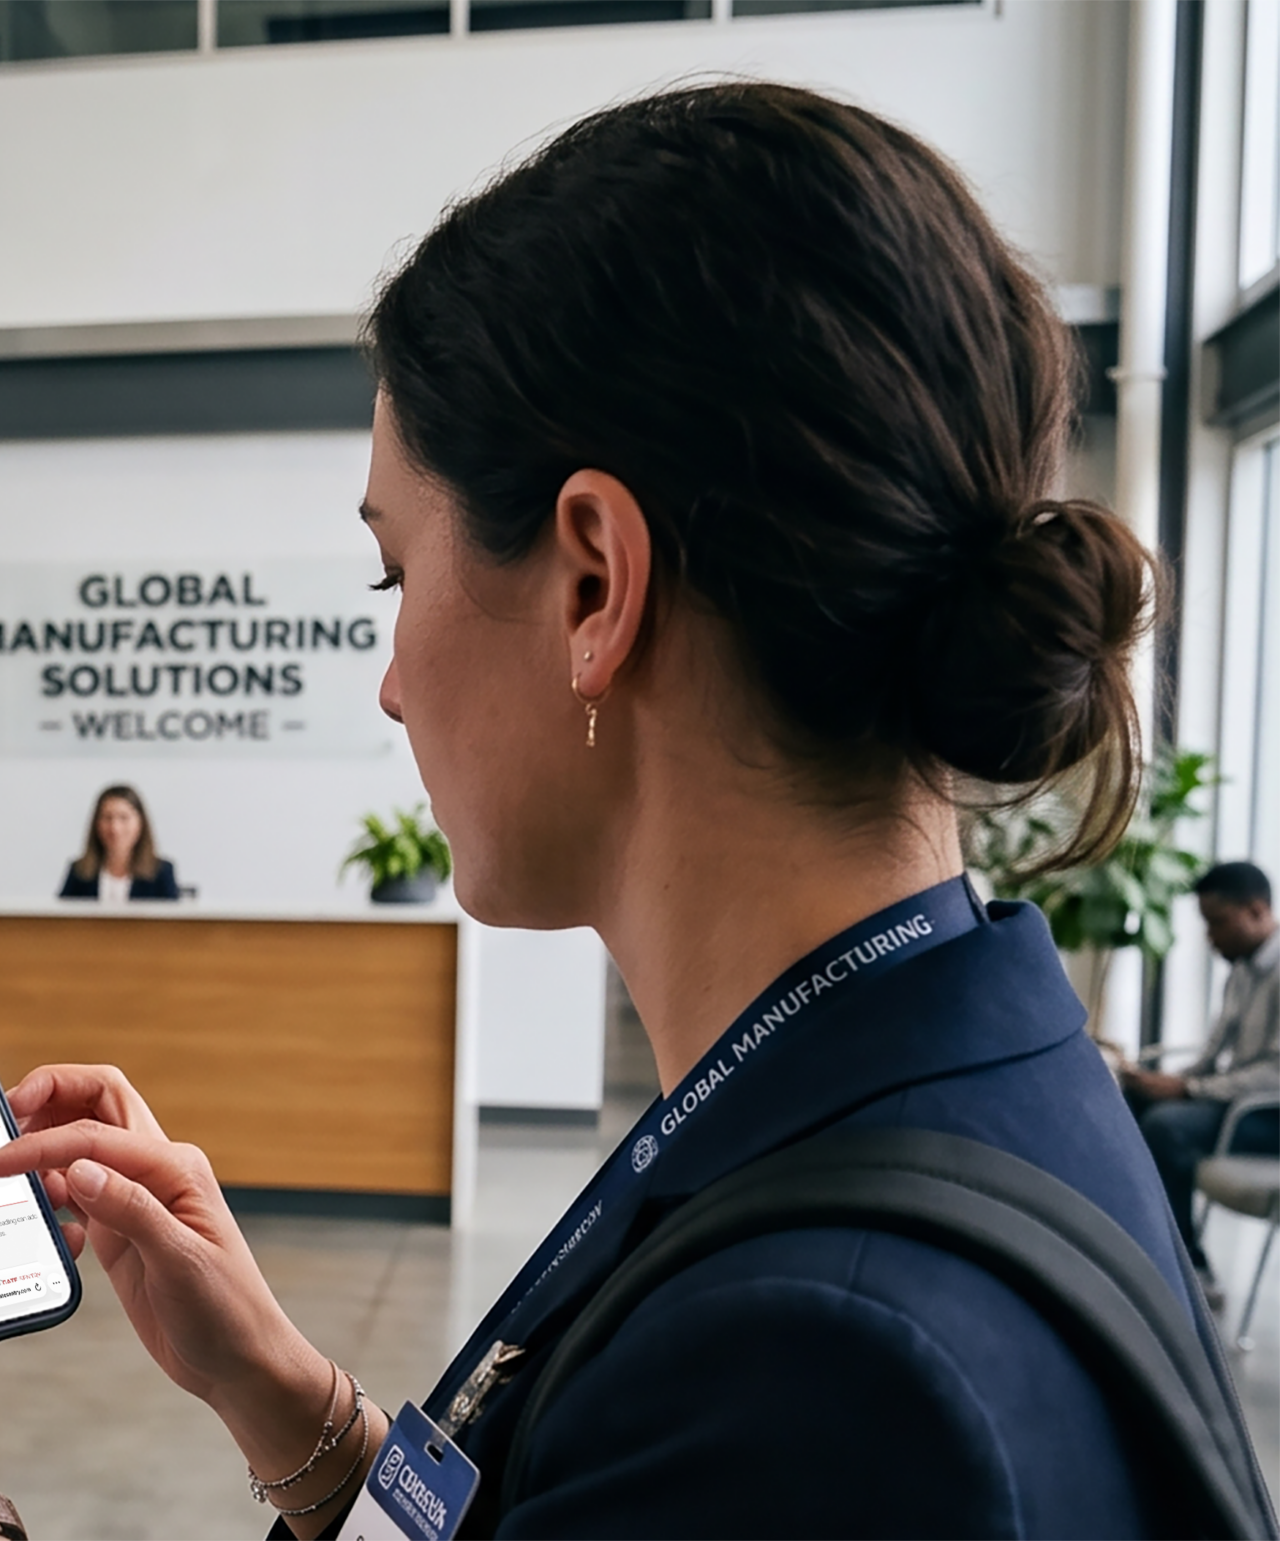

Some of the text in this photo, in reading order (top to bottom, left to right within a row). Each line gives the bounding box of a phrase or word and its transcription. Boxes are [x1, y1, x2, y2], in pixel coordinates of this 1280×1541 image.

[78, 574, 267, 610] GLOBAL
[41, 663, 304, 699] SOLUTIONS
[73, 710, 270, 741] WELCOME
[660, 914, 933, 1136] GLOBAL MANUFACTURING
